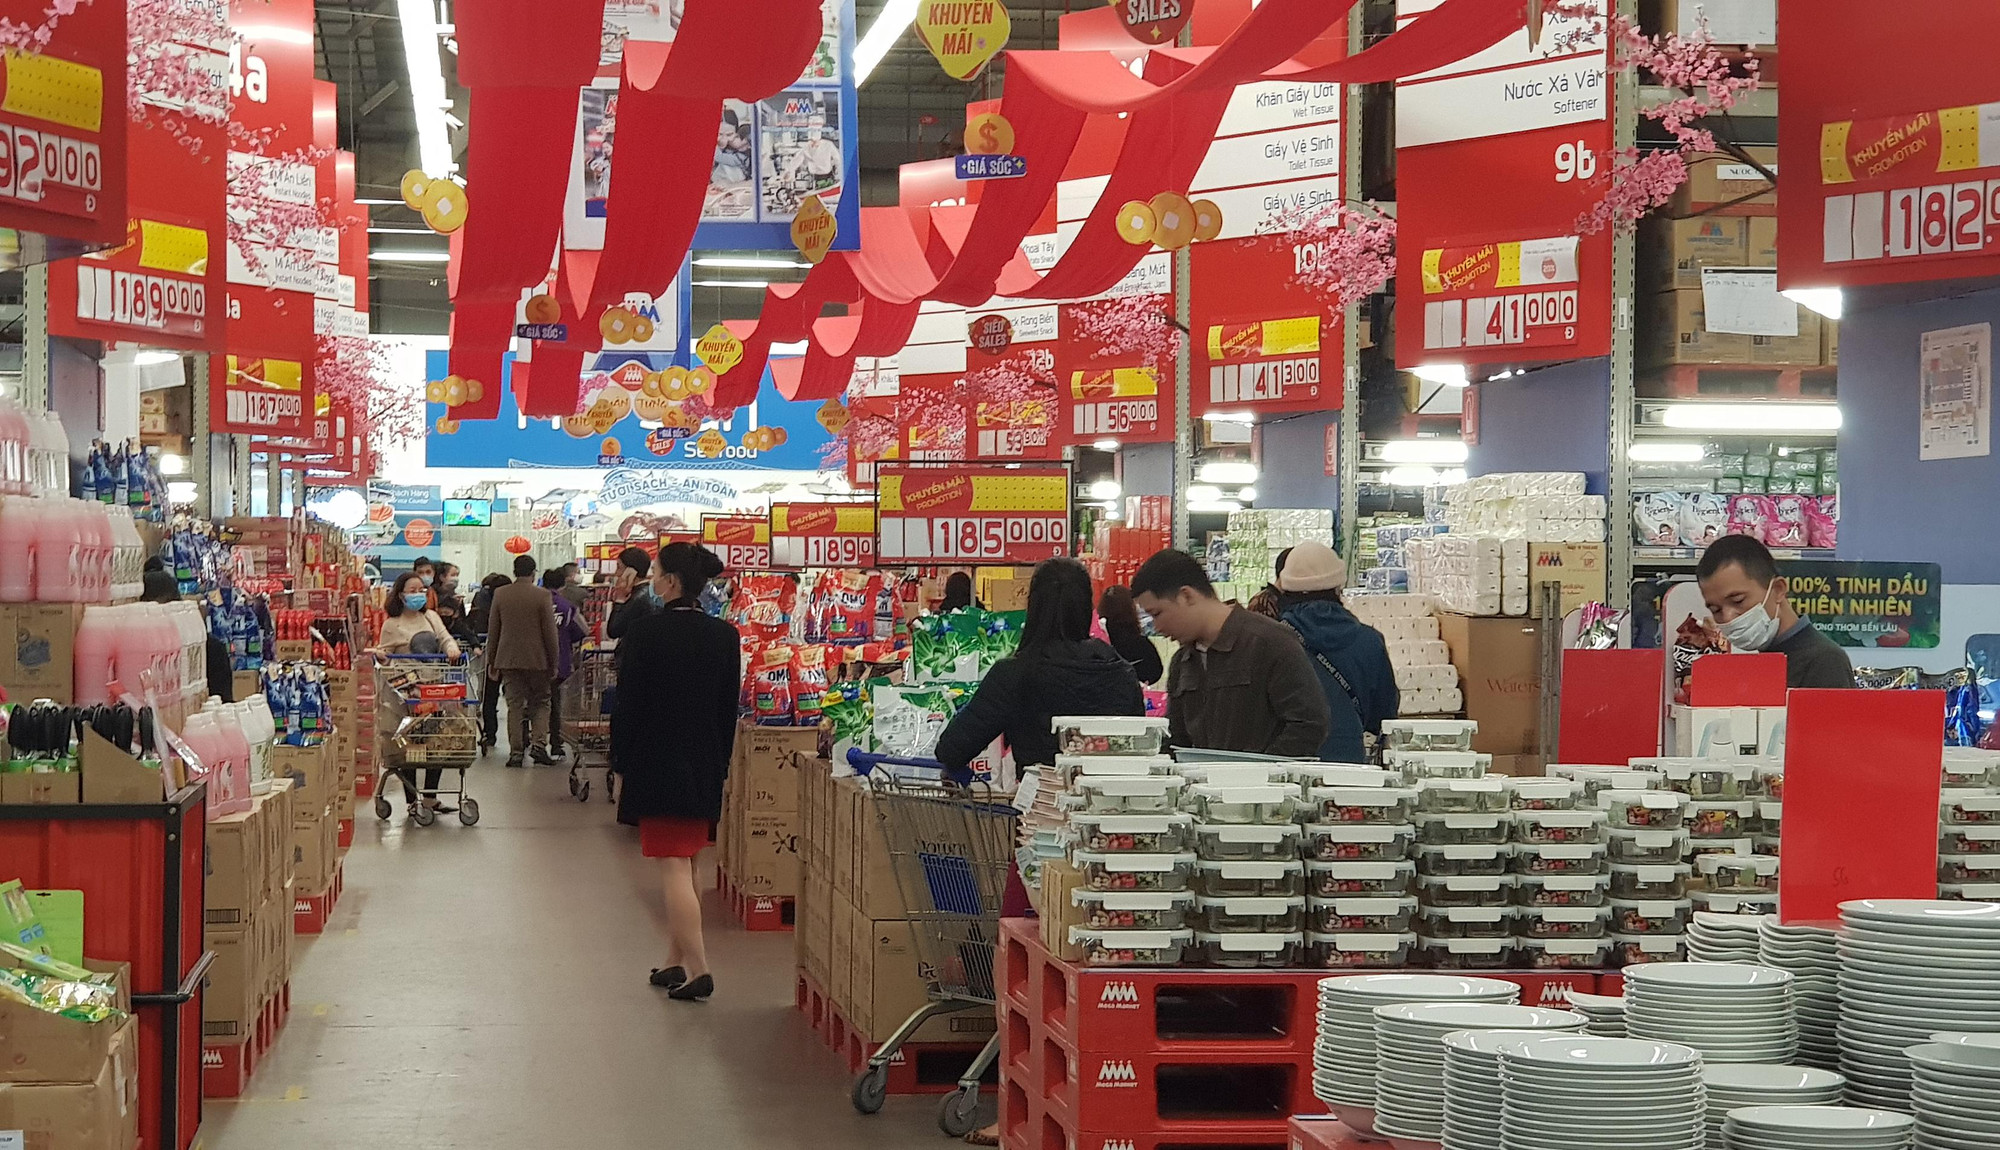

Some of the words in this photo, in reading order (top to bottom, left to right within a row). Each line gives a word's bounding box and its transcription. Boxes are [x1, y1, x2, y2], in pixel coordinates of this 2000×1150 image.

[1127, 0, 1181, 26] SALES
[942, 28, 973, 55] MÃI
[1286, 84, 1310, 105] Giấy
[1504, 79, 1543, 102] Nước
[1293, 107, 1307, 118] Wet
[1310, 104, 1334, 115] Tissue
[1553, 97, 1598, 115] Softener
[1905, 111, 1931, 137] MÃI
[1264, 141, 1288, 160] Giấy
[1291, 140, 1307, 156] Vệ
[1311, 136, 1334, 151] Sinh
[1868, 135, 1928, 177] PROMOTION
[967, 156, 987, 175] GIÁ
[989, 154, 1012, 175] SỐC
[1288, 160, 1307, 172] Toilet
[1310, 157, 1334, 168] Tissue
[1555, 139, 1596, 183] 9b
[1308, 189, 1332, 205] Sinh
[702, 340, 736, 353] KHUYẾN
[979, 333, 1007, 349] SALES
[731, 546, 769, 567] 222
[1836, 577, 1882, 594] TINH
[841, 591, 867, 606] OMO
[1847, 596, 1912, 617] NHIÊN
[1487, 677, 1543, 693] Waters
